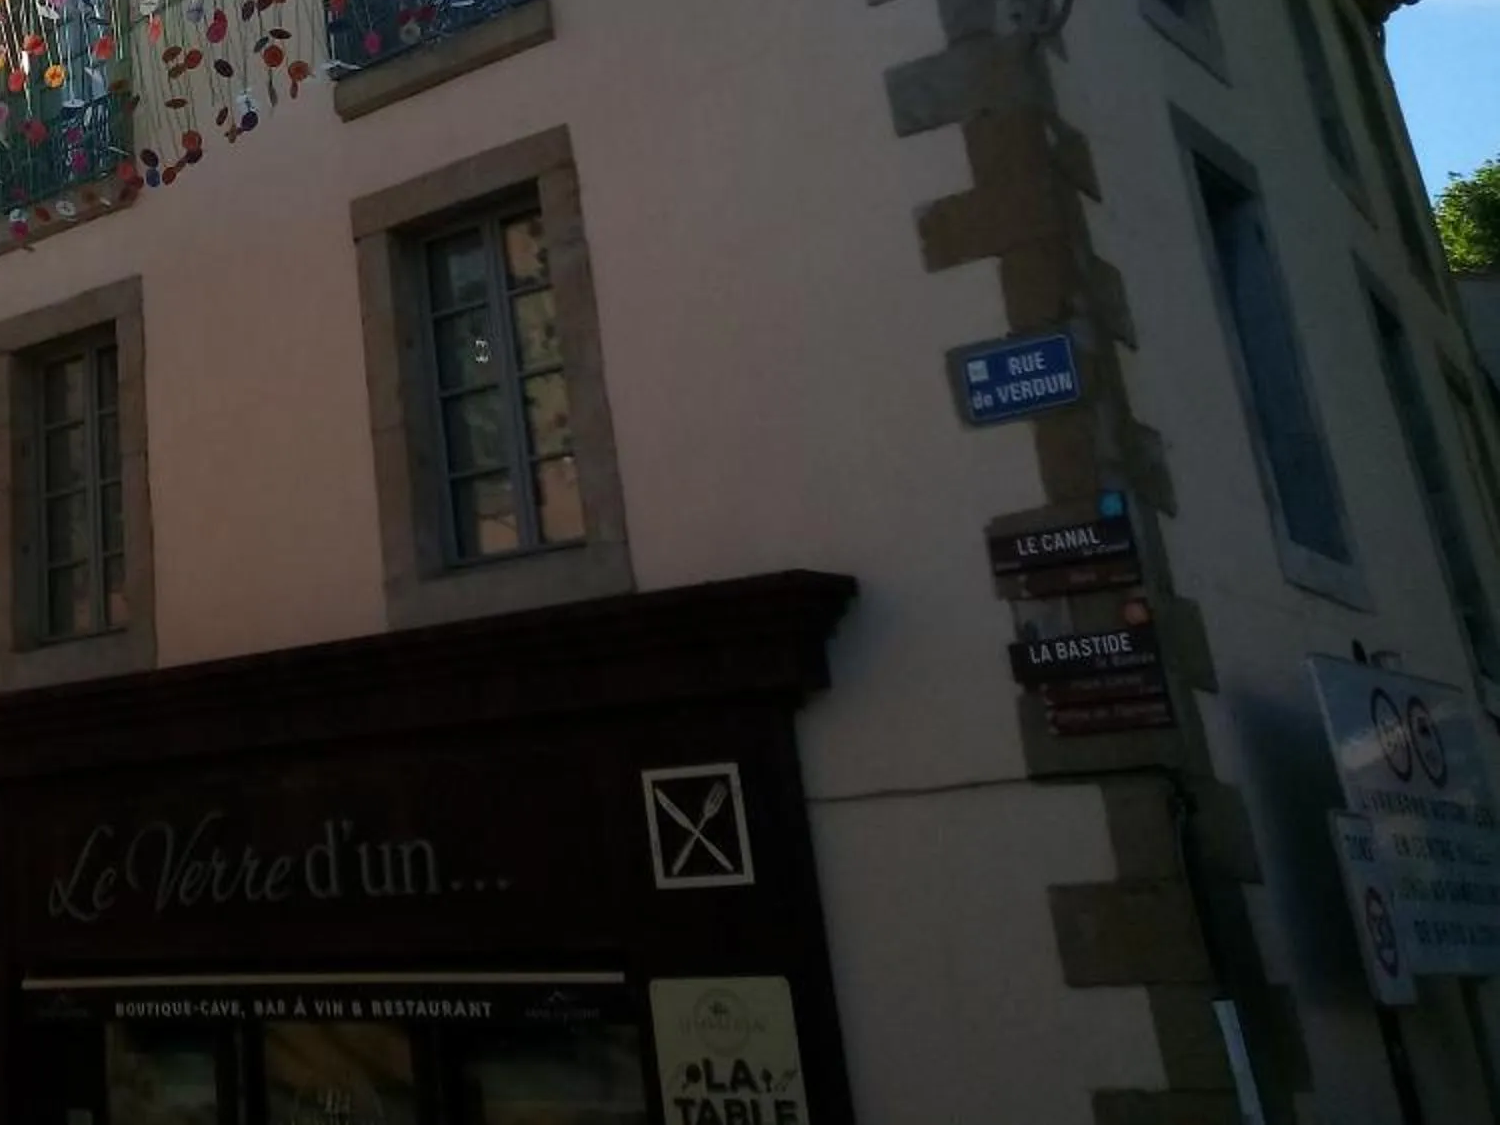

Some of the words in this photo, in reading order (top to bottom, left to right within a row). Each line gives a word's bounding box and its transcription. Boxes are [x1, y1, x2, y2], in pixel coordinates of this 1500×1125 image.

[1007, 349, 1048, 376] RUE
[971, 388, 995, 411] de
[995, 370, 1073, 404] VERDUN
[1016, 536, 1038, 557] LE
[1041, 525, 1102, 553] CANAL
[1028, 644, 1054, 665] LA
[1055, 631, 1134, 661] BASTIDE
[47, 821, 117, 924] Le
[125, 808, 300, 921] Verre
[253, 998, 286, 1017] BAR
[314, 999, 345, 1017] VIN
[371, 998, 493, 1019] RESTAURANT
[703, 1057, 764, 1093] LA
[674, 1098, 800, 1125] TABLE
